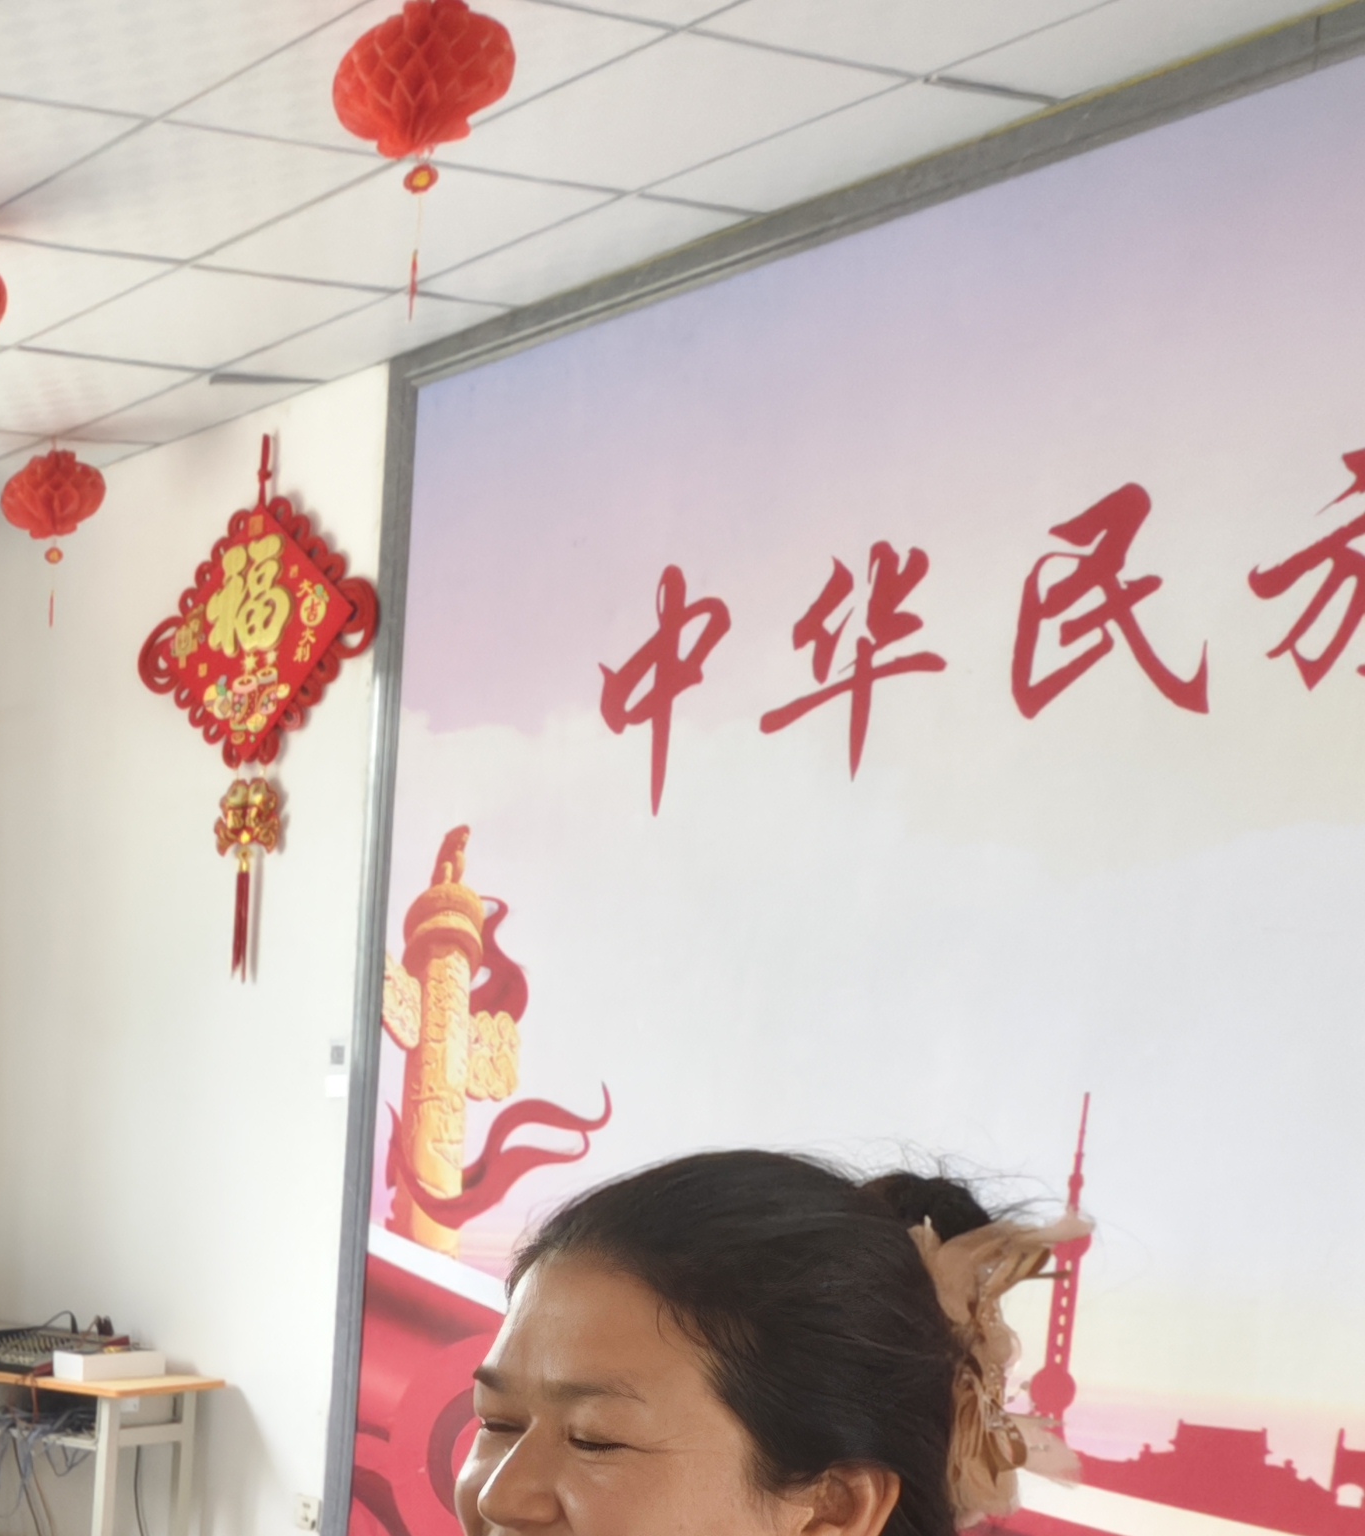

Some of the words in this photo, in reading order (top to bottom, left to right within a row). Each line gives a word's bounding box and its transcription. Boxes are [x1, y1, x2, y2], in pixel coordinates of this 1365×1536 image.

[206, 533, 292, 658] 福
[293, 578, 327, 663] 大吉大利
